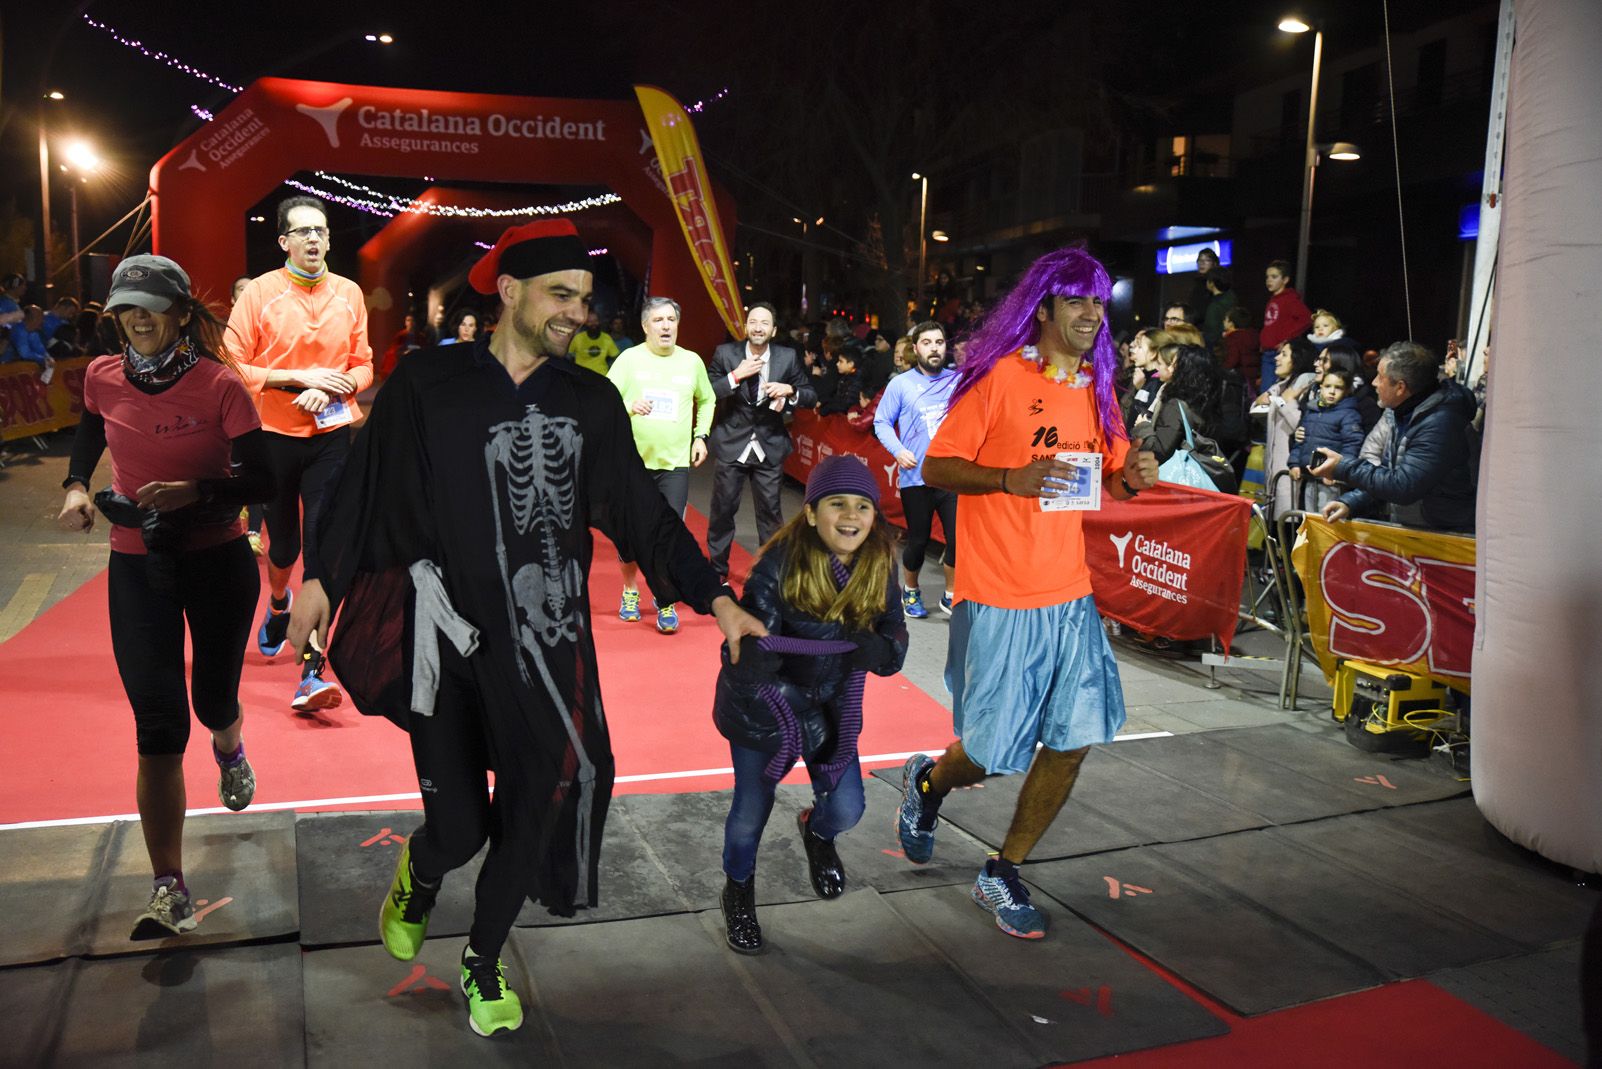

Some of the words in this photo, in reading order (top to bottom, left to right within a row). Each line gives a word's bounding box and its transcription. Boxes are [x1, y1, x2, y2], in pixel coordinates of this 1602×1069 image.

[201, 108, 254, 151] Catalana
[209, 118, 264, 161] Occident
[358, 106, 482, 136] Catalana
[487, 114, 606, 141] Occident
[360, 133, 479, 154] Assegurances
[1031, 426, 1058, 448] 16
[1056, 440, 1081, 450] edició
[1135, 534, 1191, 570] Catalana
[1130, 575, 1187, 604] Assegurances
[1132, 555, 1187, 591] Occident
